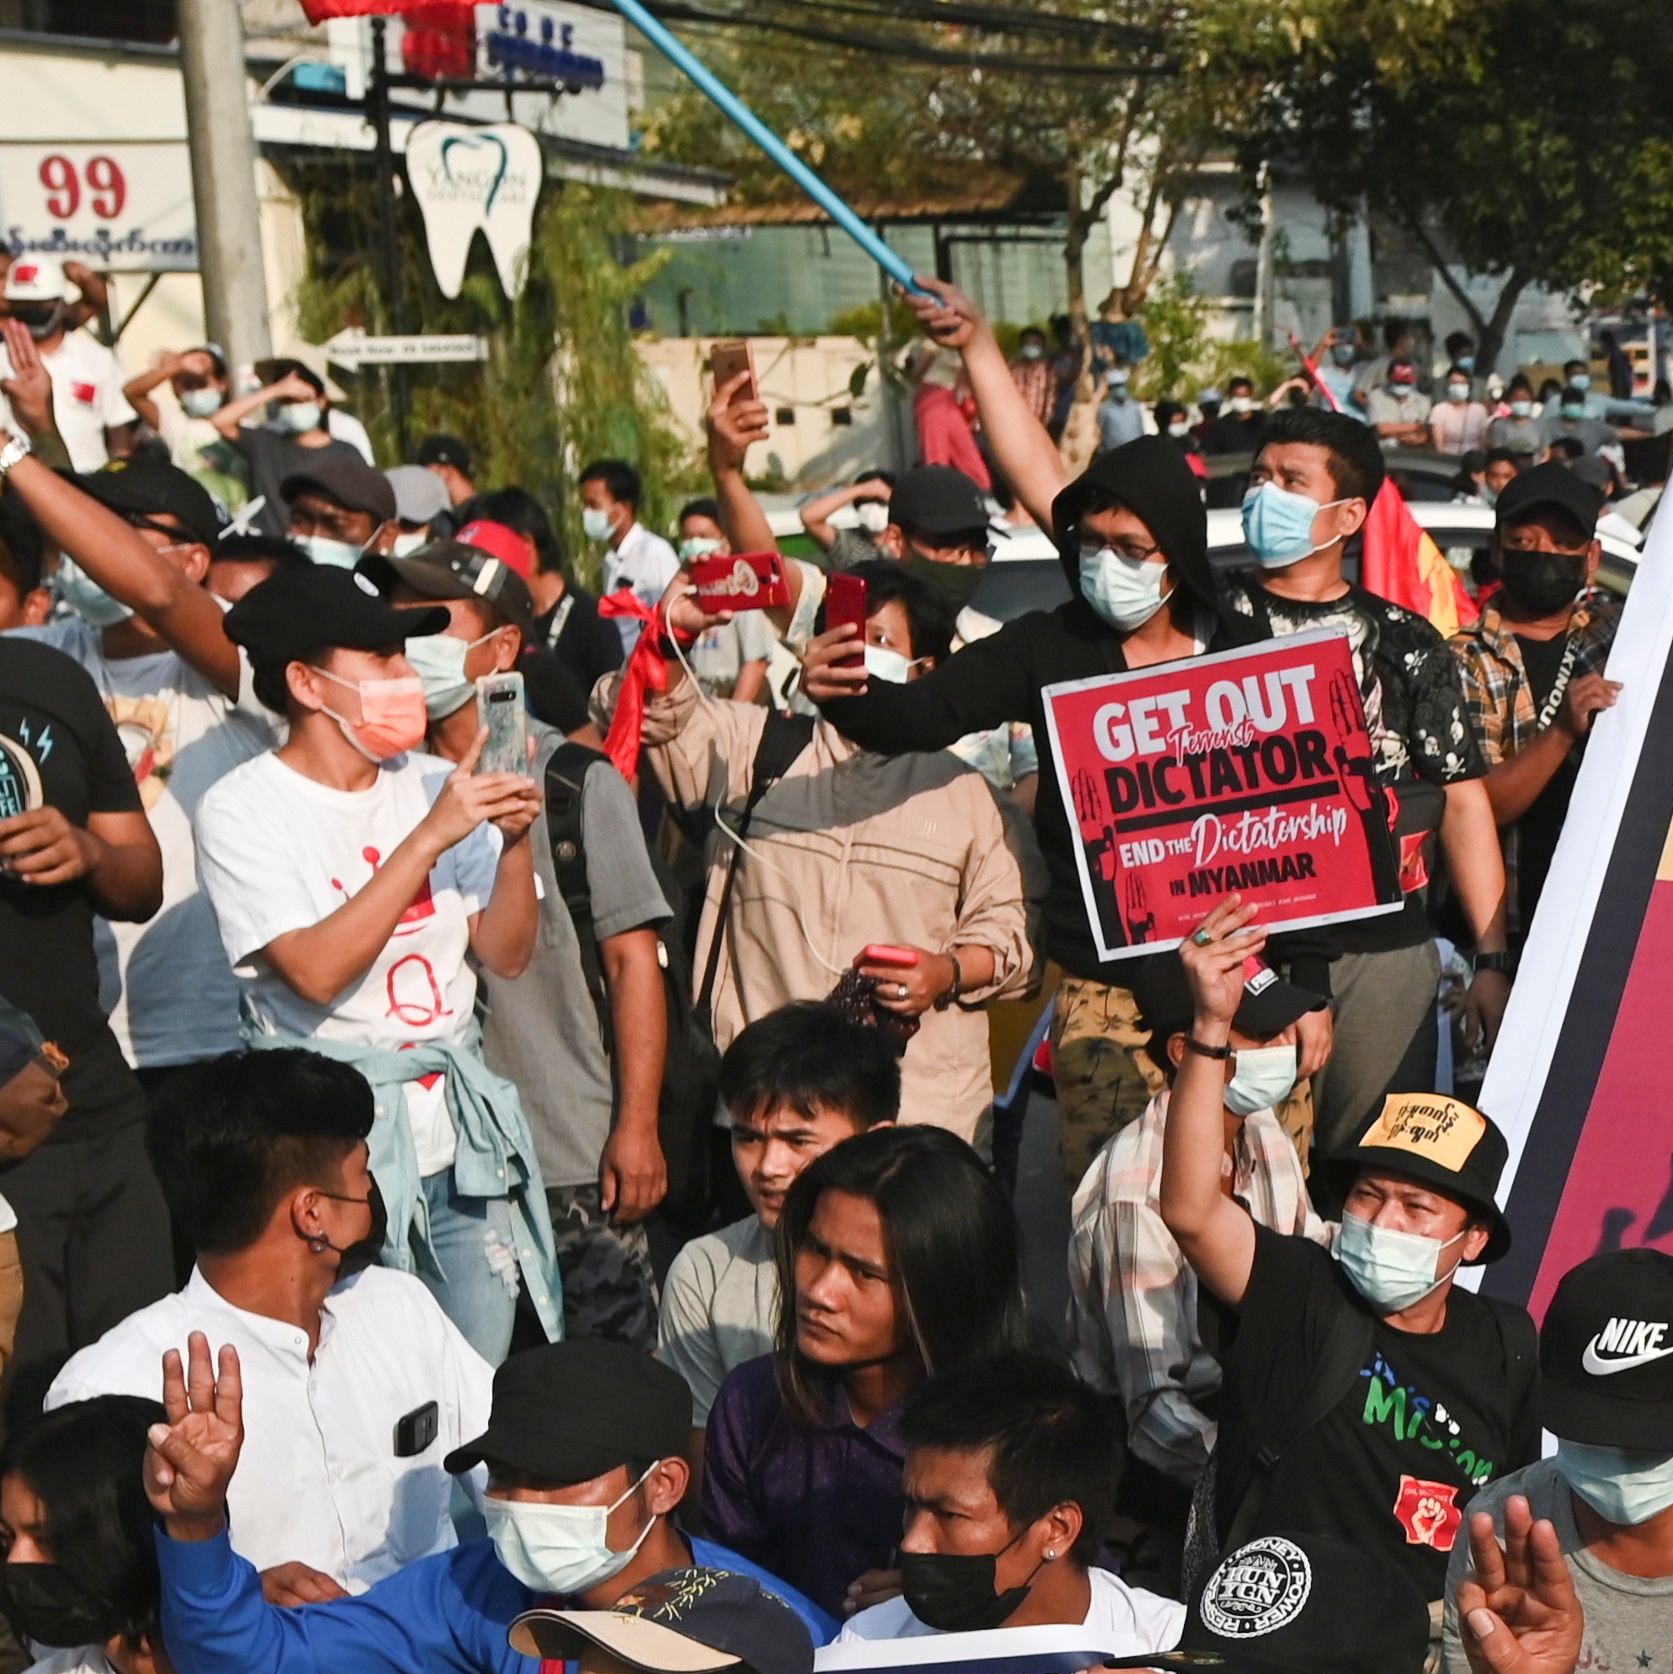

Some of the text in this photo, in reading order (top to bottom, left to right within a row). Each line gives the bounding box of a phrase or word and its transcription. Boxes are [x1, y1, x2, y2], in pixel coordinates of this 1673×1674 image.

[39, 155, 126, 220] 99
[1093, 664, 1316, 763] GET OUT
[1104, 729, 1335, 816] DICTATOR
[1119, 803, 1347, 869] END THE Dictatorship
[1169, 852, 1318, 898] IN MYANMAR
[386, 953, 452, 1028] Q
[1597, 1317, 1669, 1355] NIKE
[1254, 1570, 1305, 1632] POWER
